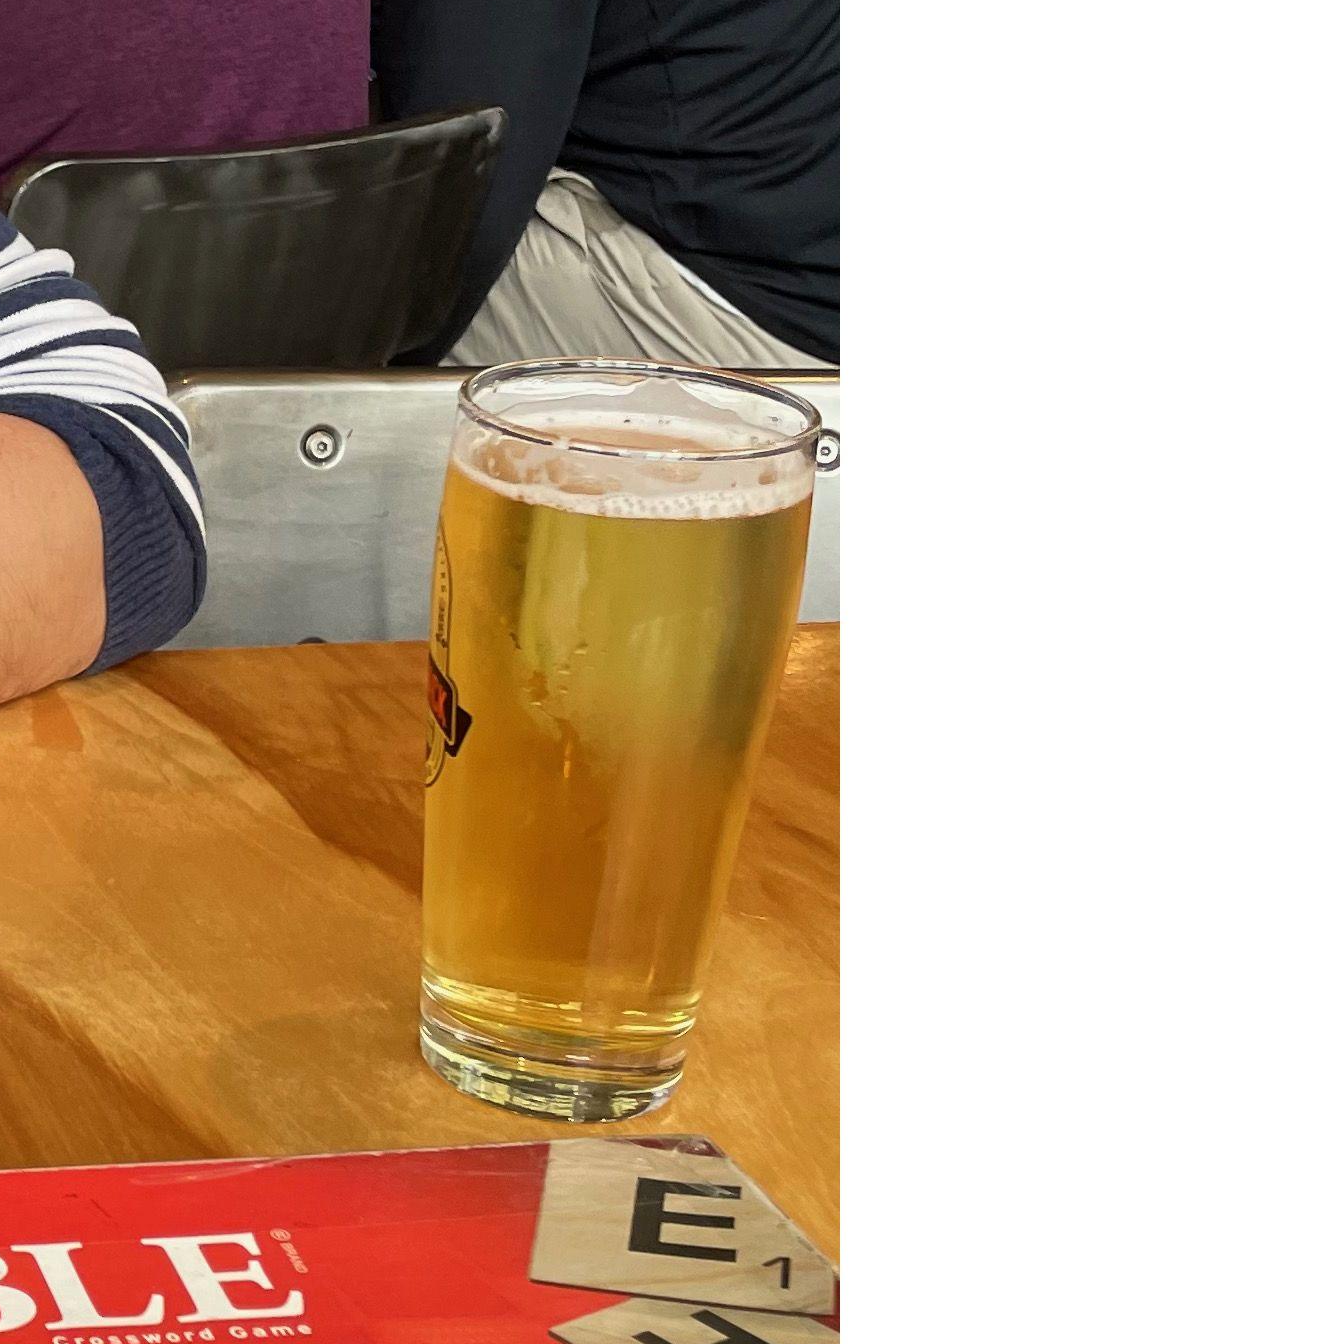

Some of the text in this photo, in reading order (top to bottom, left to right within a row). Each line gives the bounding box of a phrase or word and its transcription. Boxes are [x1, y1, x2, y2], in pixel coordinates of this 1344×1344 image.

[628, 1177, 794, 1289] E 1
[228, 1324, 312, 1340] Game
